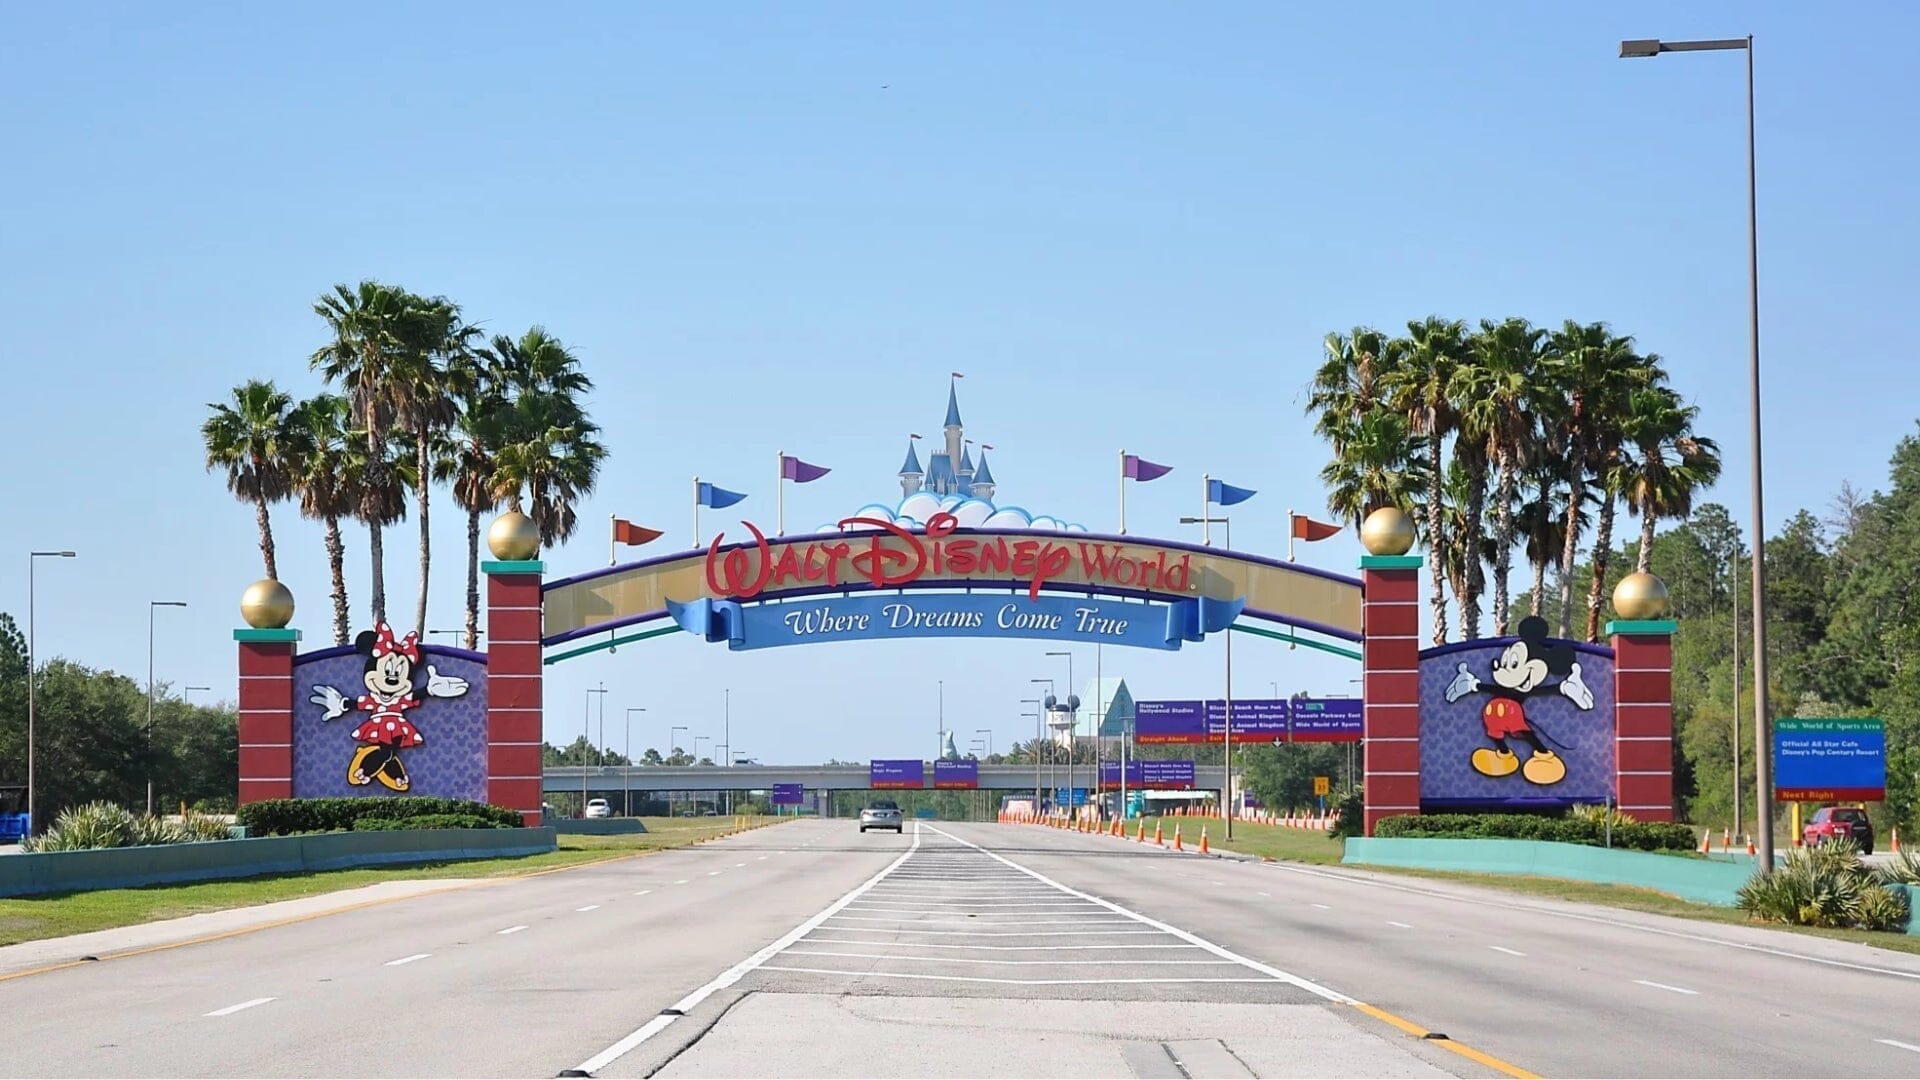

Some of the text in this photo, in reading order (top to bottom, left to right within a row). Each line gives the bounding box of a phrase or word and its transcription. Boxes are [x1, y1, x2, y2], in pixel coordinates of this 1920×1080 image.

[1078, 542, 1190, 591] World
[784, 602, 1129, 635] Where Dreams Come True
[1837, 723, 1860, 731] Sports
[1809, 792, 1833, 800] Right
